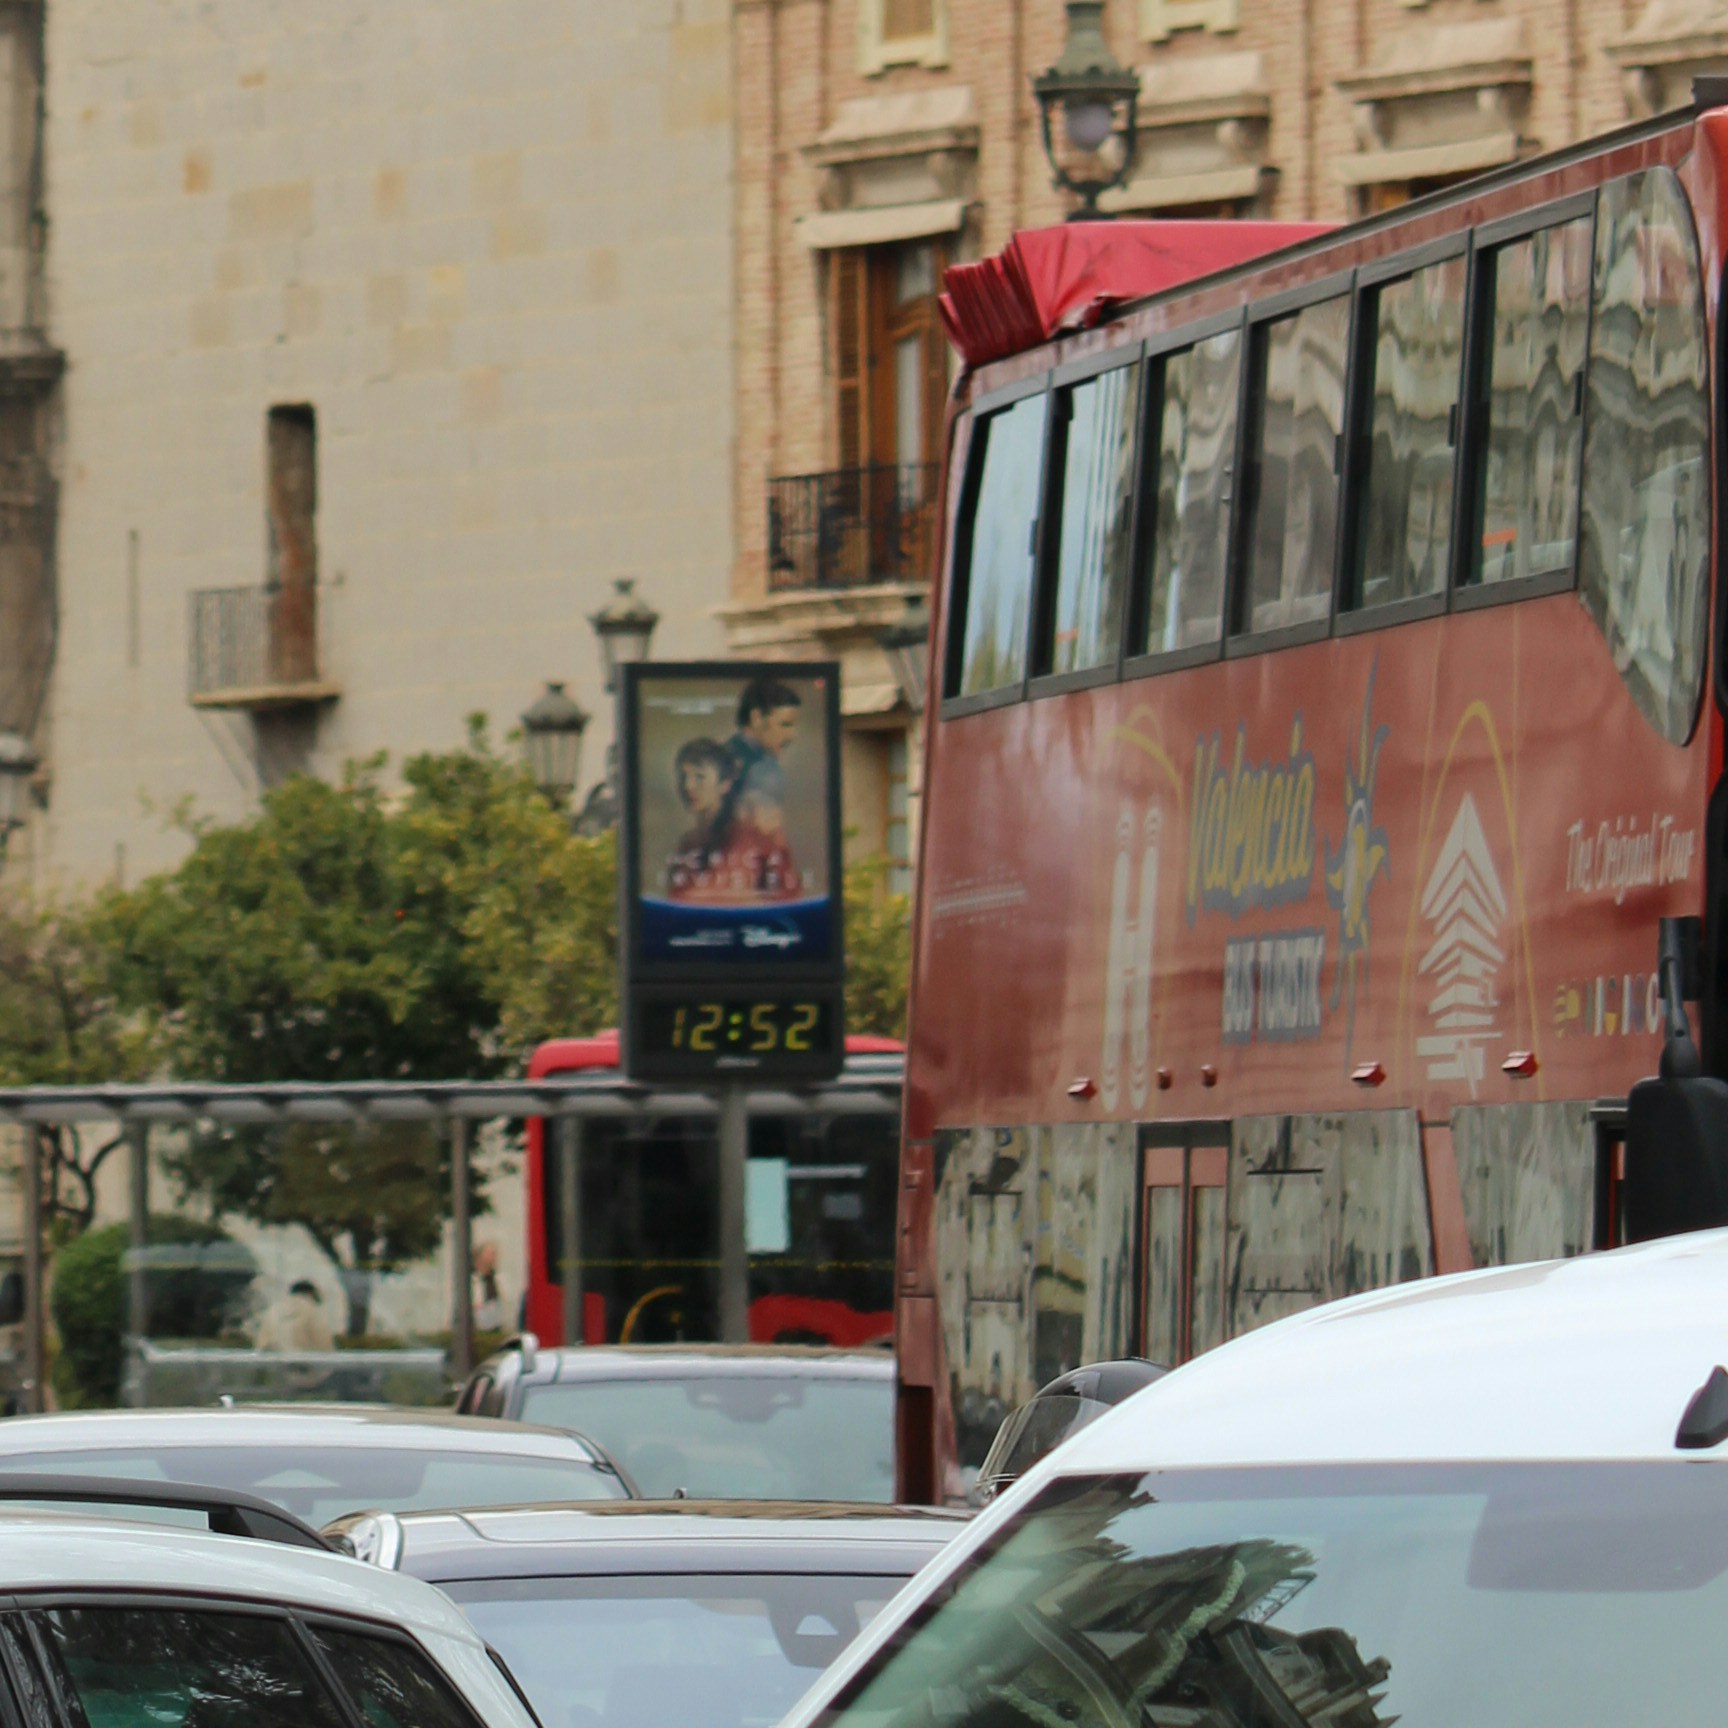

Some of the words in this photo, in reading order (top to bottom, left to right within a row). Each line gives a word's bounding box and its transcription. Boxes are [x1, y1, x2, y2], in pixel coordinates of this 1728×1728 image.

[1566, 818, 1593, 894] The
[1594, 813, 1657, 905] Original
[1659, 815, 1694, 886] Tour
[672, 1003, 819, 1051] 12:52
[1223, 941, 1256, 1033] BUS
